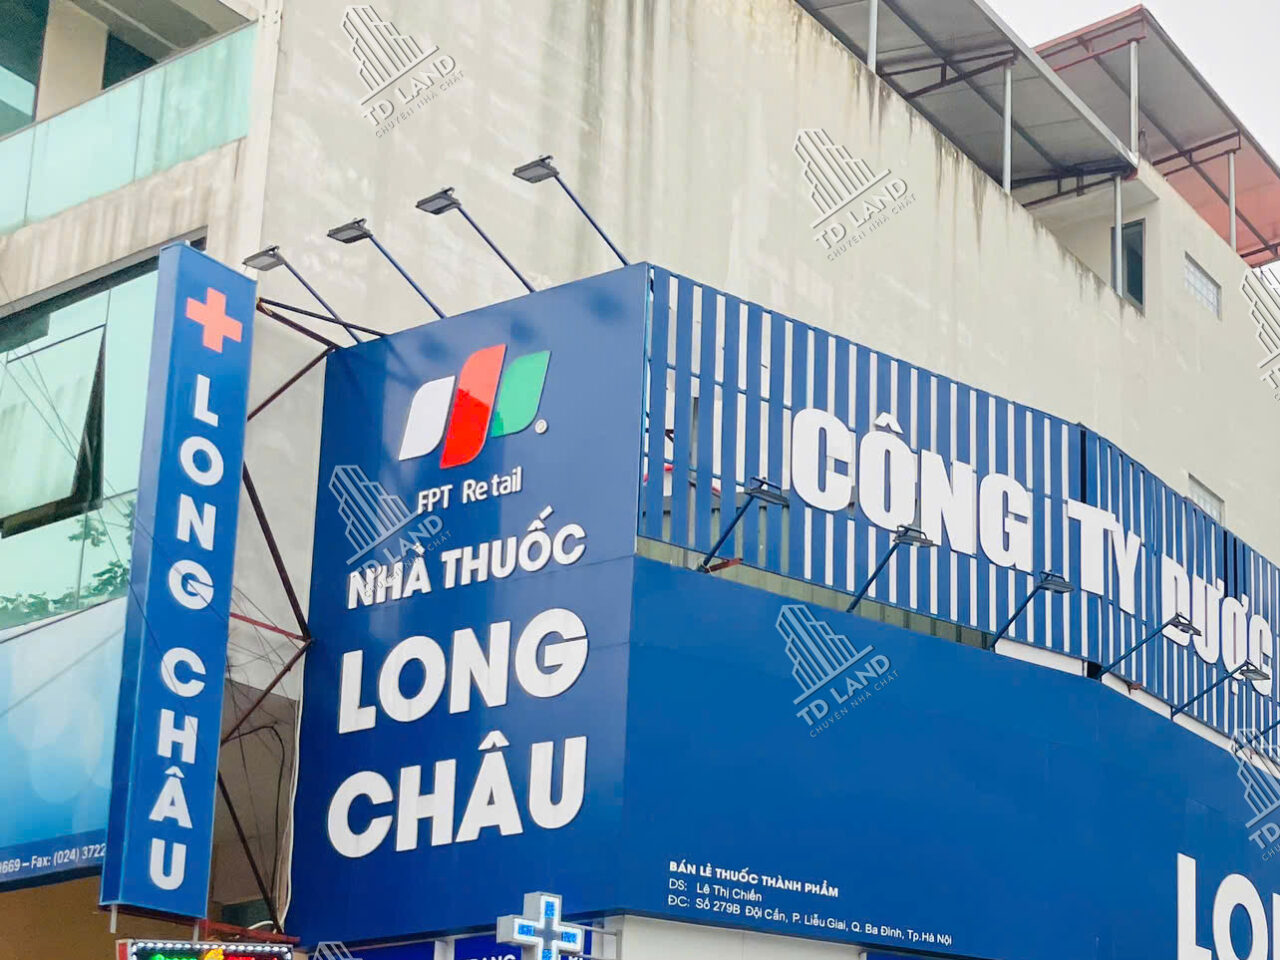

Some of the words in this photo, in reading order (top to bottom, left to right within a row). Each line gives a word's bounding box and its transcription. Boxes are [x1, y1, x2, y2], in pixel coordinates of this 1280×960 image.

[168, 374, 225, 610] LONG
[417, 485, 453, 514] FPT
[347, 541, 433, 609] NHÀ
[440, 505, 586, 589] THUỐC
[792, 408, 1034, 574] CÔNG
[1068, 498, 1142, 615] TY
[1161, 552, 1273, 696] DƯỢC
[338, 607, 588, 735] LONG
[149, 647, 207, 891] CHÂU
[327, 730, 587, 859] CHÂU
[31, 855, 51, 869] Fax:
[53, 848, 80, 866] (024)
[81, 843, 107, 859] 3722
[669, 859, 697, 875] BÁN
[699, 863, 713, 878] LẺ
[715, 867, 759, 884] THUỐC
[761, 875, 802, 892] THÀNH
[805, 880, 839, 897] PHẨM
[669, 878, 688, 891] DS:
[696, 882, 710, 894] Lê
[713, 885, 730, 899] Thị
[667, 894, 690, 907] ĐC:
[695, 898, 711, 910] Số
[713, 901, 741, 915] 279B
[745, 905, 763, 919] Đội
[792, 913, 801, 923] P.
[851, 921, 863, 932] Q.
[865, 923, 878, 935] Ba
